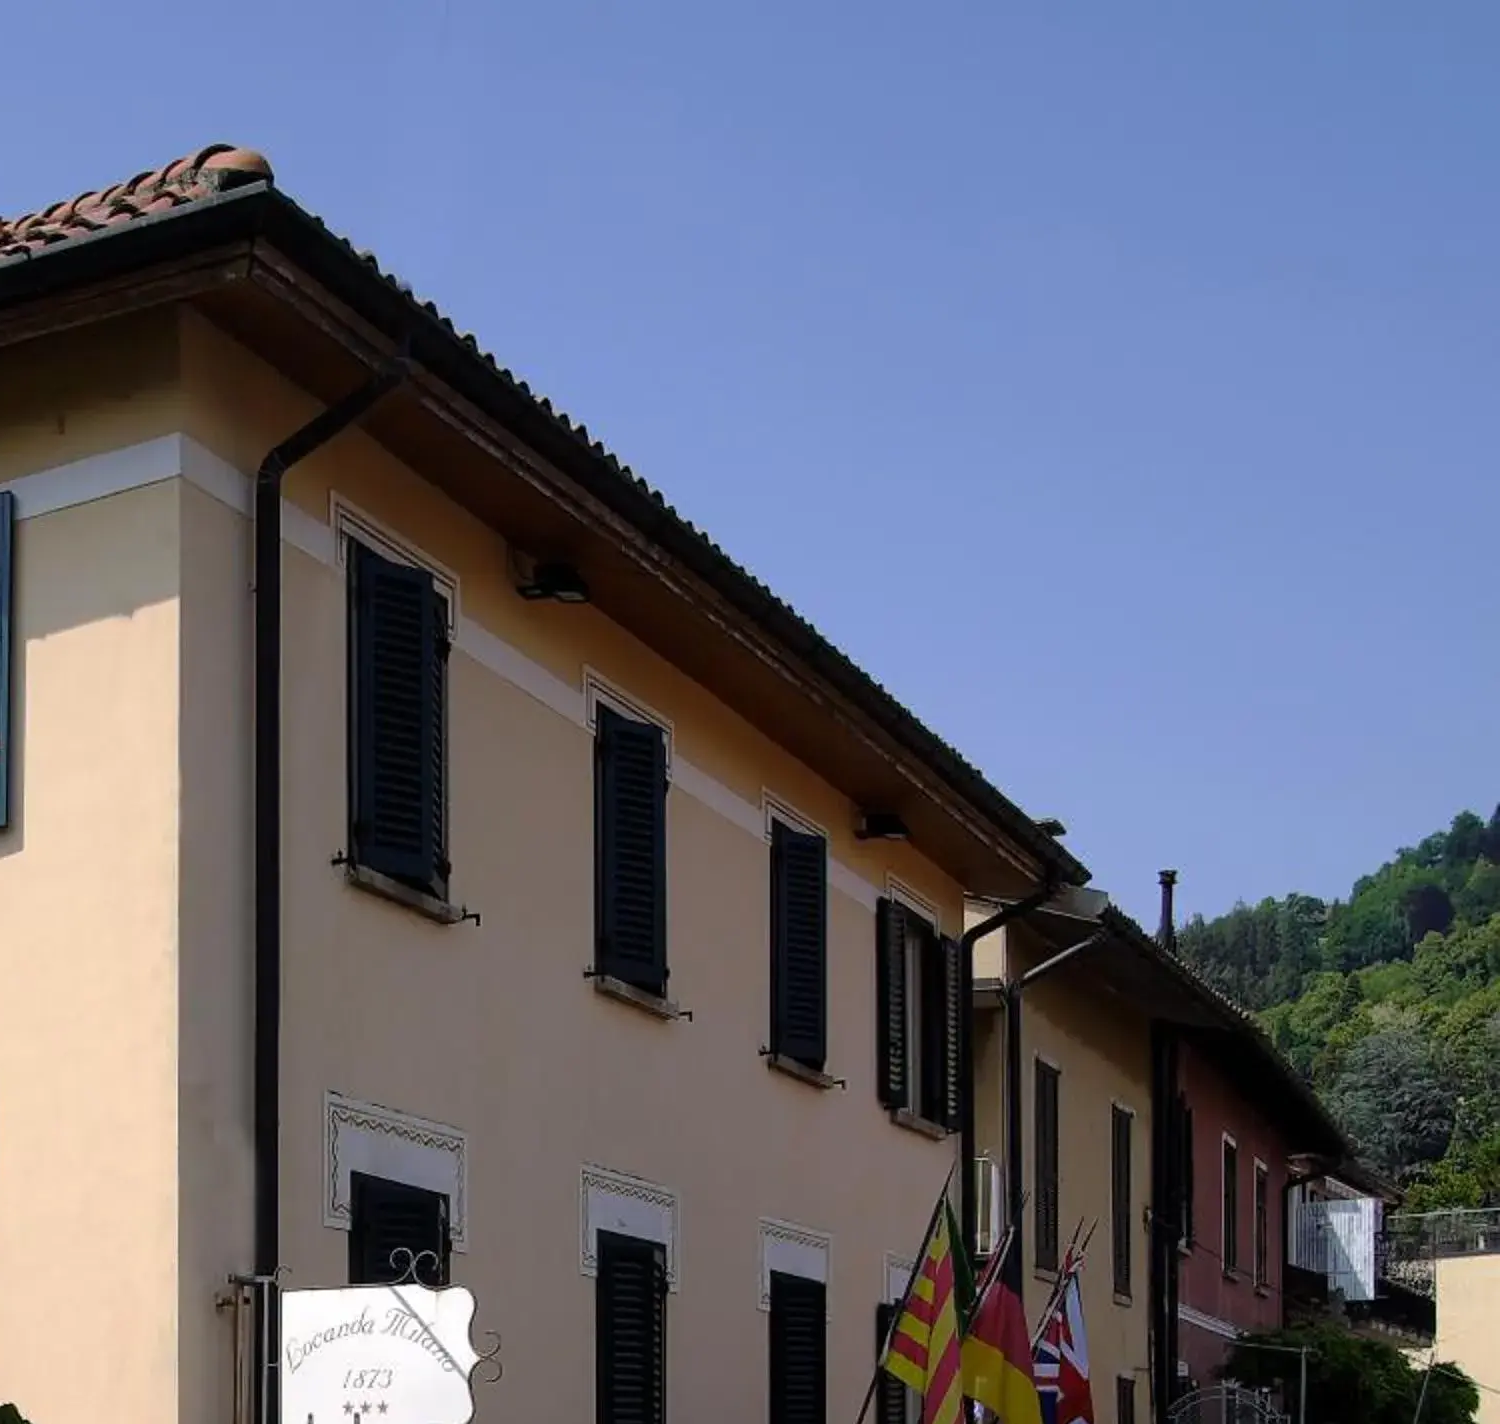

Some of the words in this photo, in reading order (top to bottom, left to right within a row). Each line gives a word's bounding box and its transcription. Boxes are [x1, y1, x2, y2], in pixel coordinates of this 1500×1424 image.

[286, 1304, 375, 1375] Locanda
[380, 1307, 456, 1373] Milano
[343, 1368, 393, 1390] 1873
